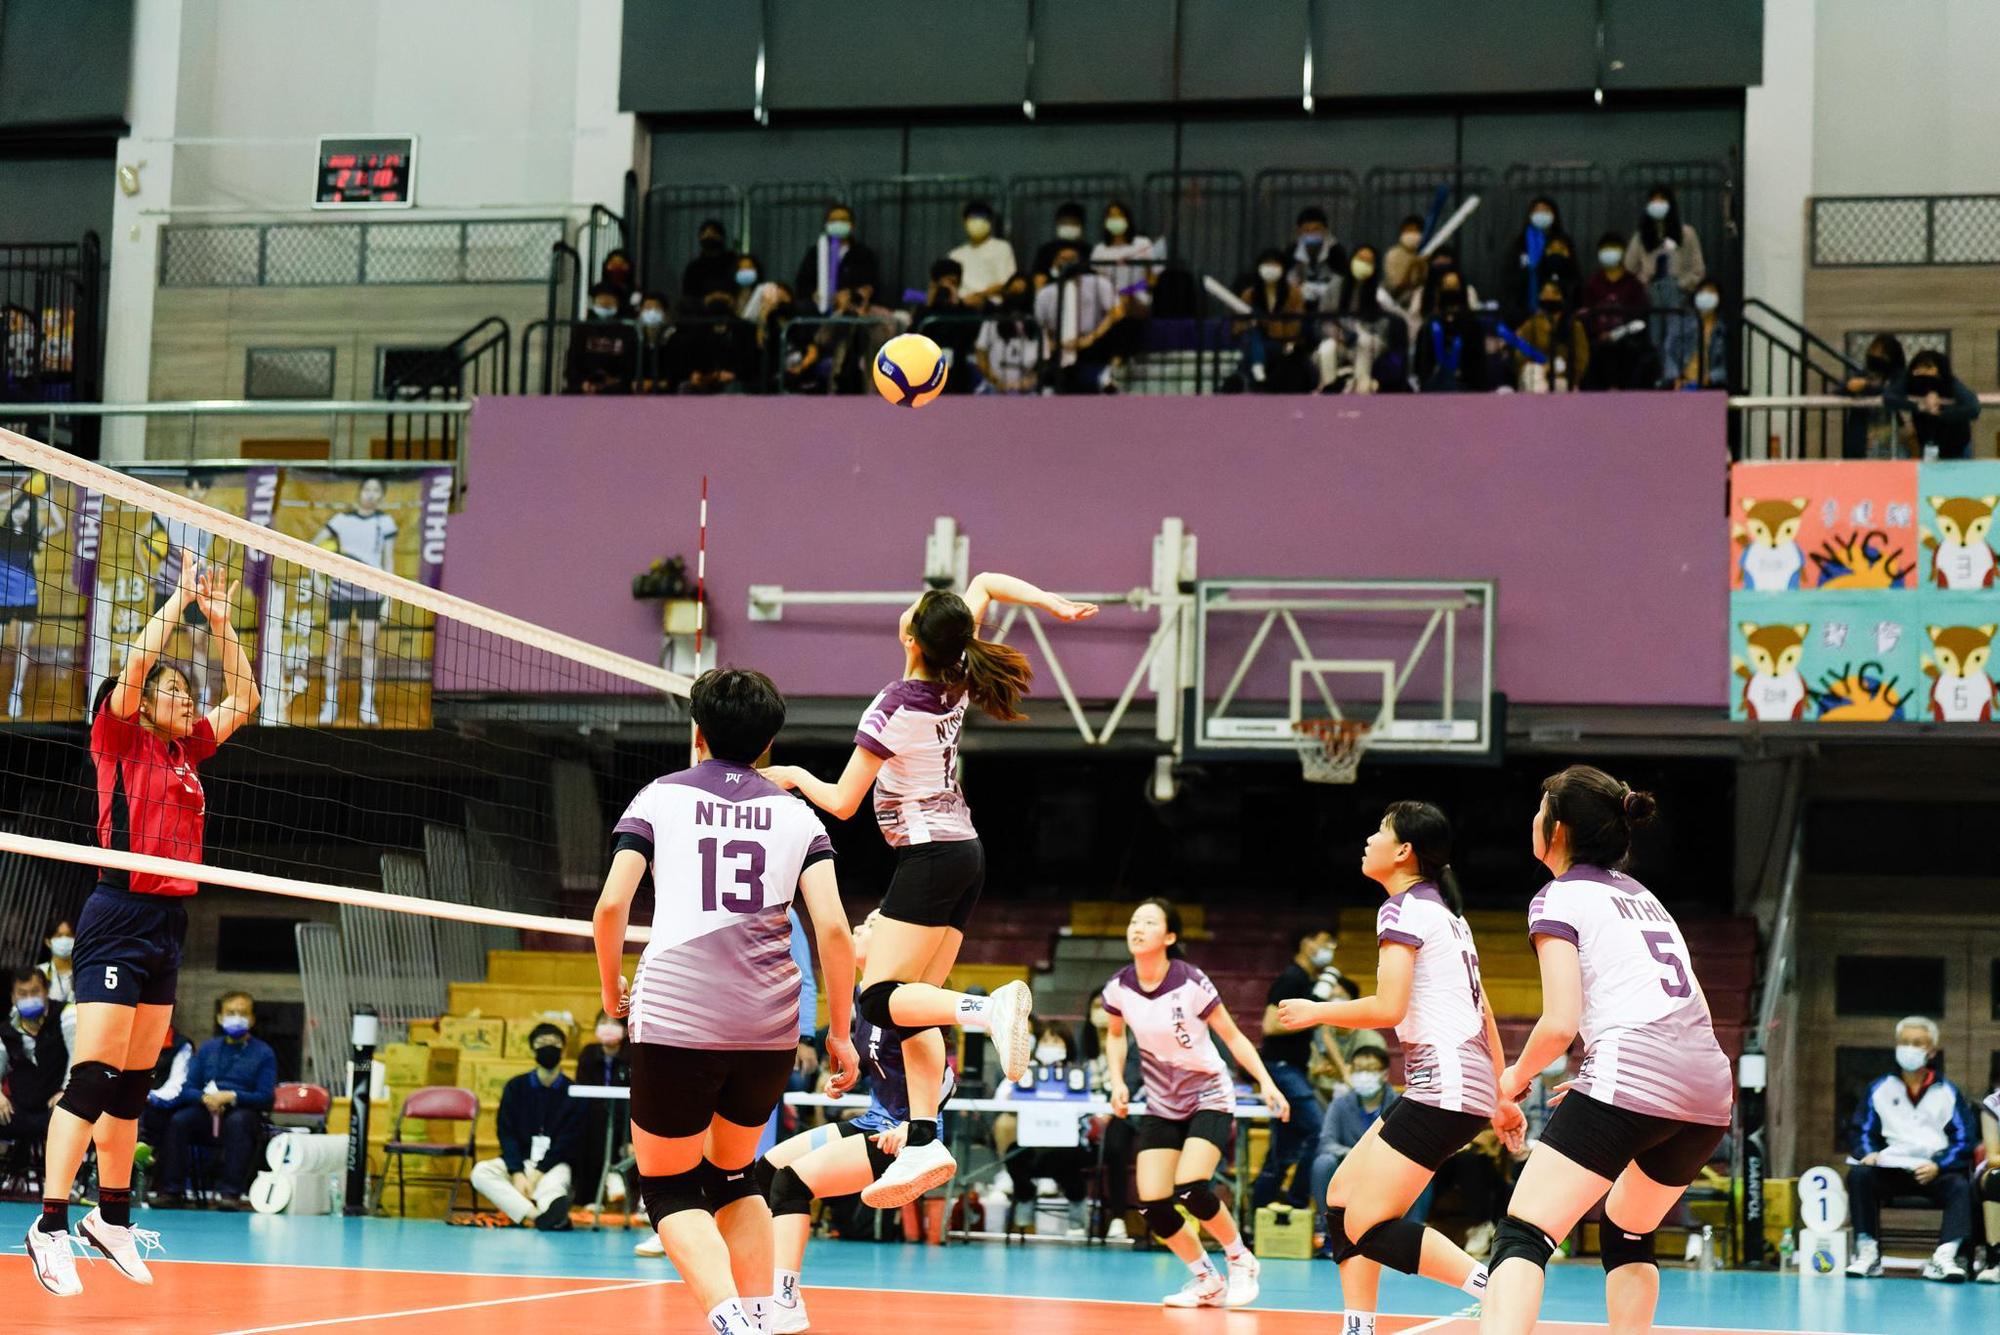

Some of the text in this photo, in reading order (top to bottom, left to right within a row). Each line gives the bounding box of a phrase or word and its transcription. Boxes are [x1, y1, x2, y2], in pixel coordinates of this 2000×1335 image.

[423, 475, 453, 565] NTHU
[695, 800, 772, 831] NTHU
[698, 837, 767, 914] 13
[1610, 895, 1673, 923] NTHU
[104, 965, 118, 990] 5
[1640, 930, 1692, 998] 5
